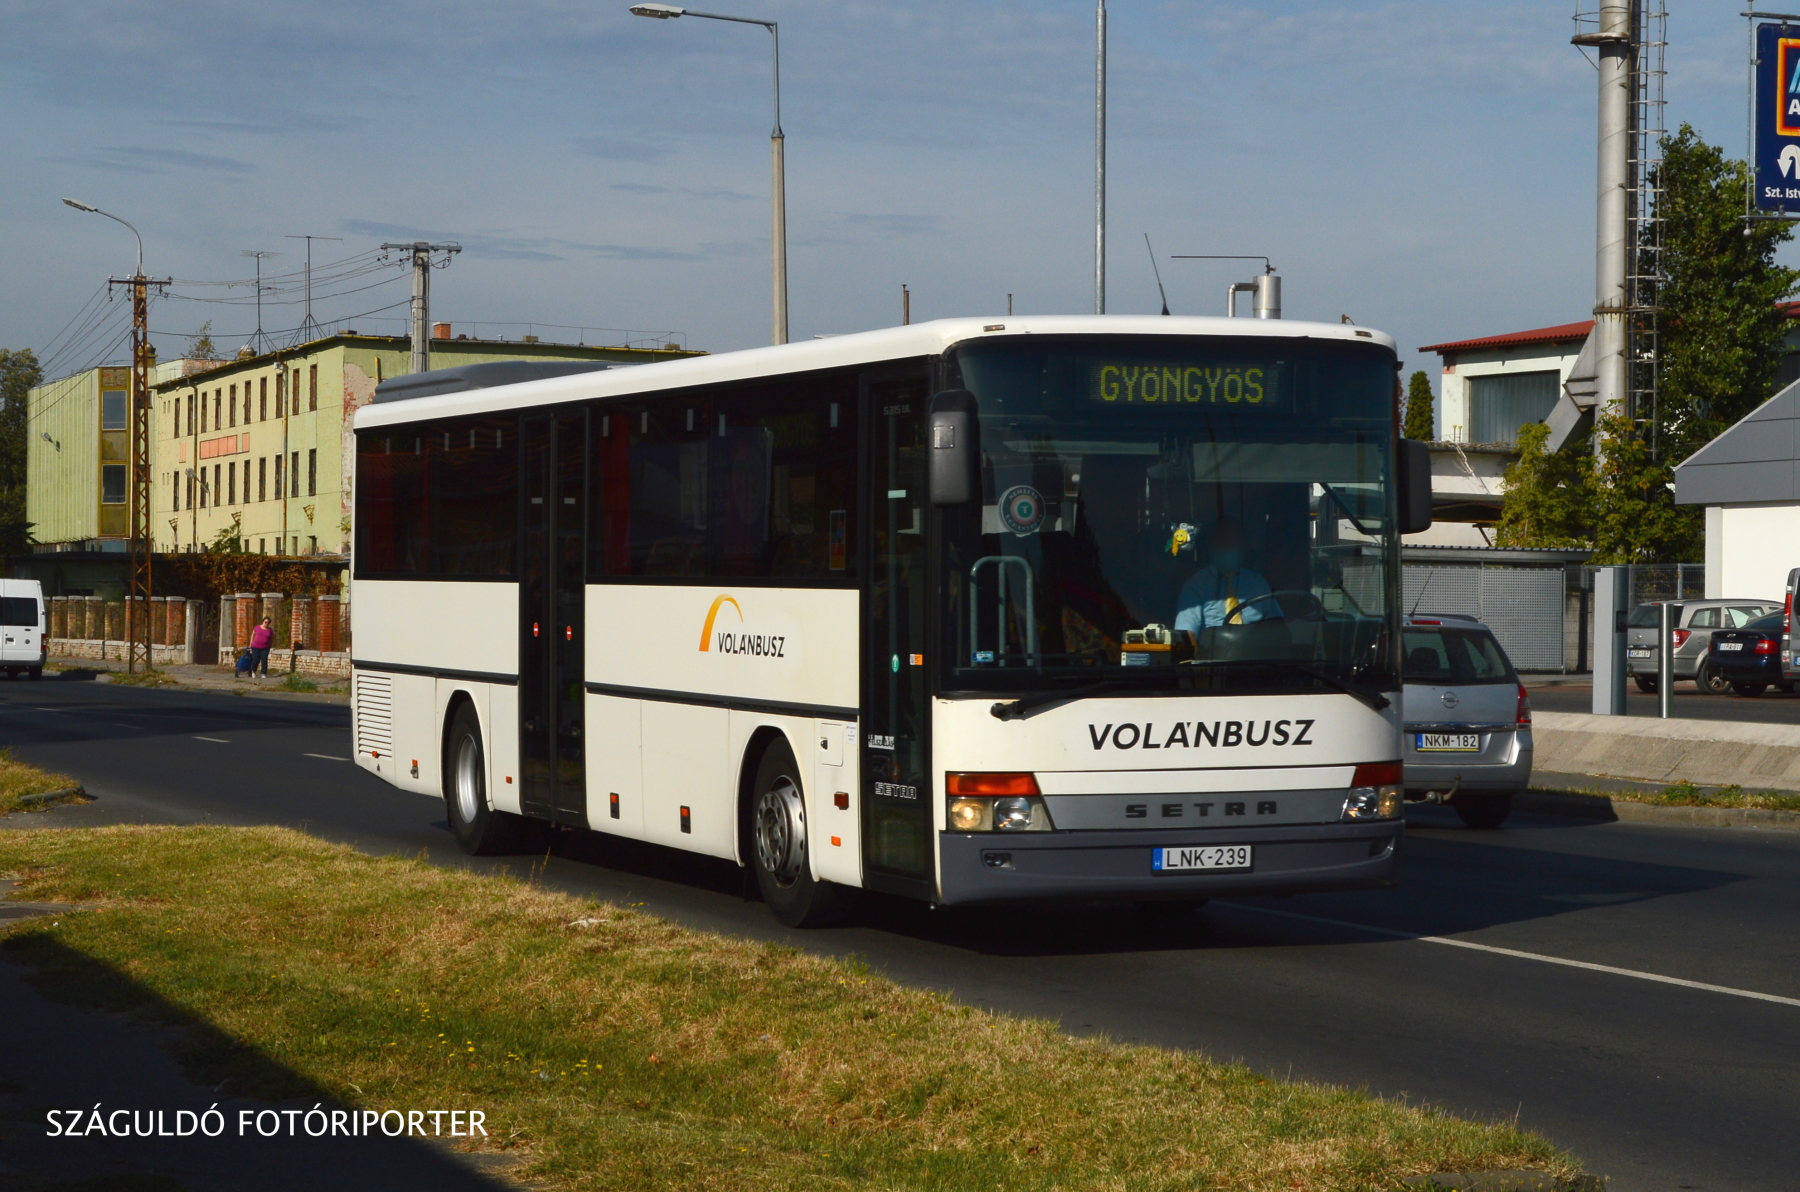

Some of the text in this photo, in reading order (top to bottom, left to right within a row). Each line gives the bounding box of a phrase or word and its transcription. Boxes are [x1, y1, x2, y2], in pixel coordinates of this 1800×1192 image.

[1765, 186, 1783, 198] Szt.
[1100, 365, 1263, 403] GYÖNGYÖS
[1009, 488, 1038, 500] NEMZETI
[718, 632, 785, 658] VOLÁNBUSZ
[1088, 719, 1316, 751] VOLÁNBUSZ
[1425, 735, 1477, 747] NKM-182
[875, 781, 917, 800] SETRA
[1125, 800, 1277, 819] SETRA
[1166, 847, 1247, 868] LNK-239
